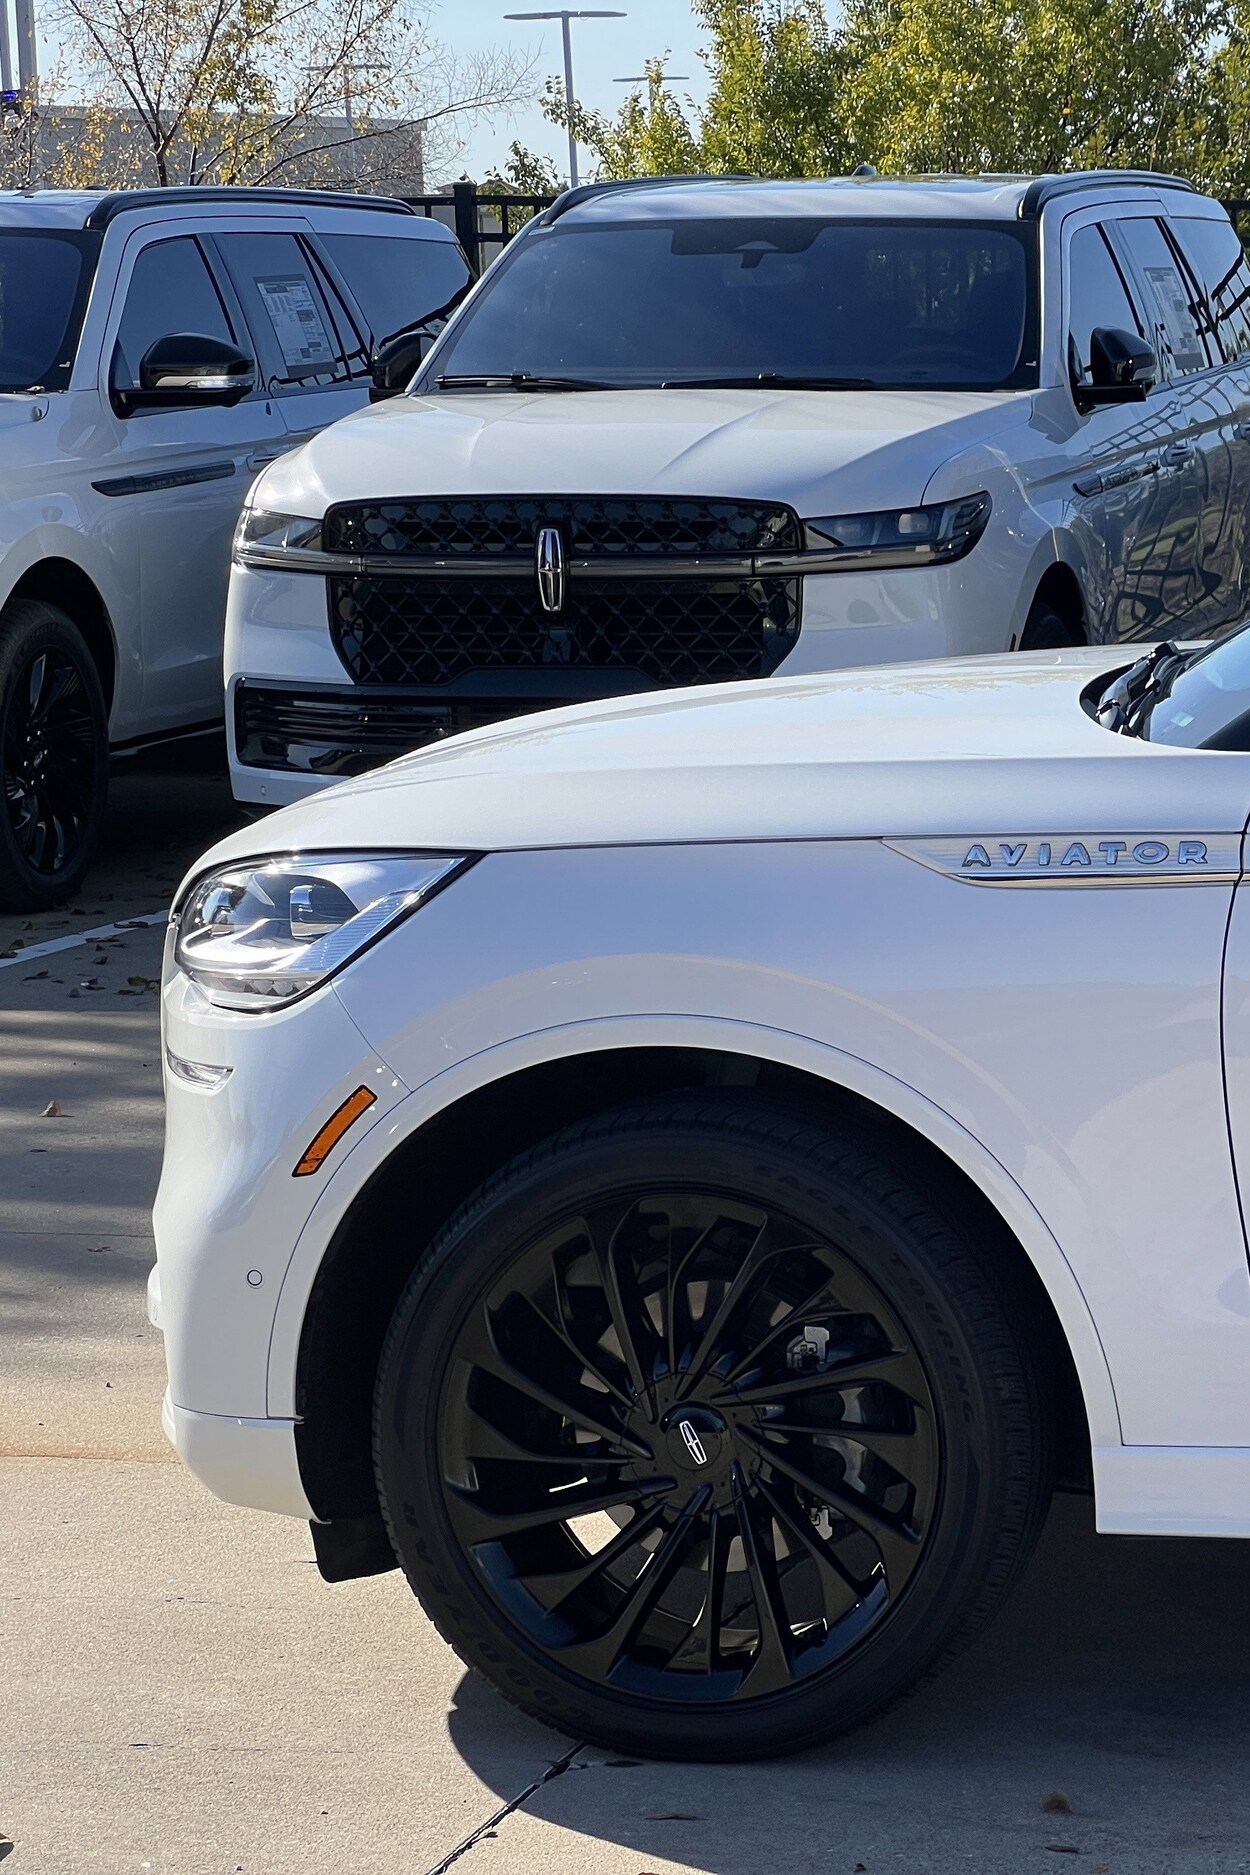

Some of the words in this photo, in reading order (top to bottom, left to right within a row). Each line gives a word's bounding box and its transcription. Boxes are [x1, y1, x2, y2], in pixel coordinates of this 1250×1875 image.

[961, 841, 1208, 867] AVIATOR
[754, 1165, 882, 1240] EAGLE
[890, 1252, 975, 1424] TOURING
[403, 1502, 588, 1720] GOODYEAR
